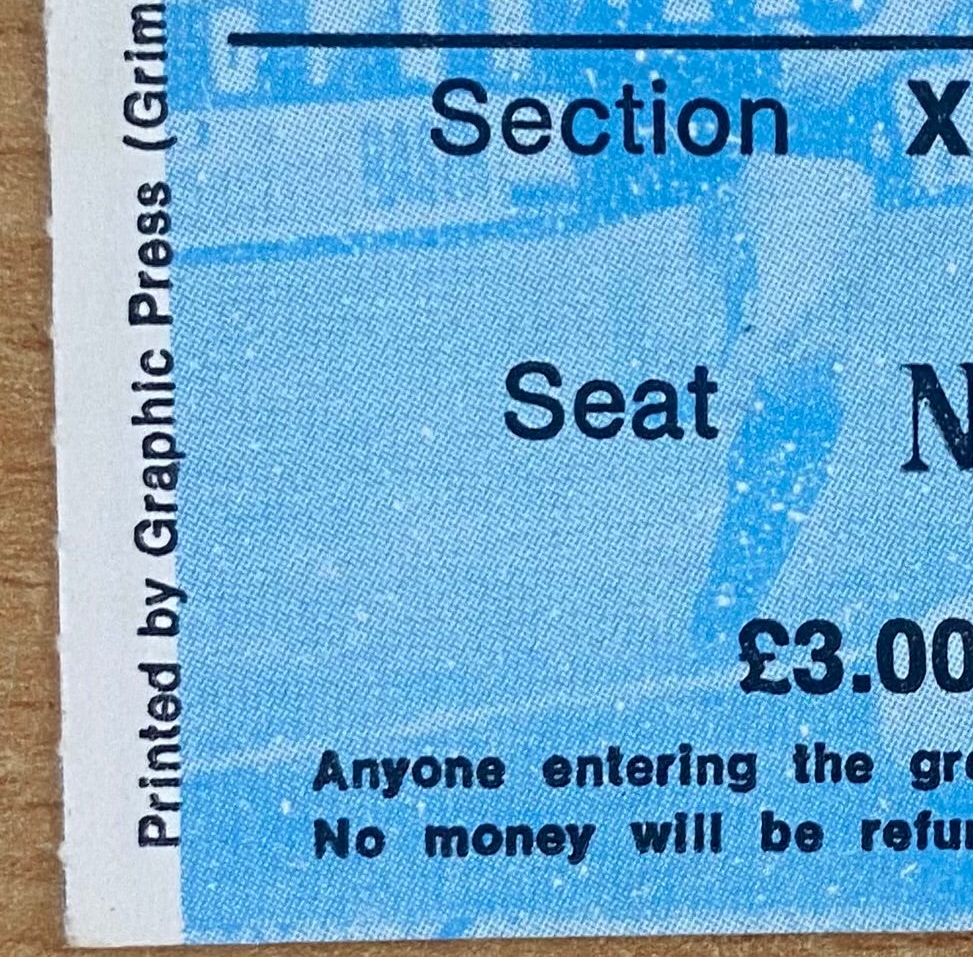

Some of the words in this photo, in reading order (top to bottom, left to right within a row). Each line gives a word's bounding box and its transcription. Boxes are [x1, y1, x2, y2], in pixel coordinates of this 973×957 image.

[431, 79, 787, 156] Section
[906, 80, 970, 156] X
[128, 182, 173, 325] Press
[504, 361, 719, 440] Seat
[131, 350, 185, 556] Graphic
[137, 578, 187, 636] by
[138, 663, 182, 847] Printed
[313, 750, 505, 796] Anyone
[543, 744, 757, 793] entering
[793, 743, 873, 783] the
[314, 818, 385, 859] No
[425, 824, 595, 864] money
[630, 813, 721, 854] will
[761, 811, 823, 852] be
